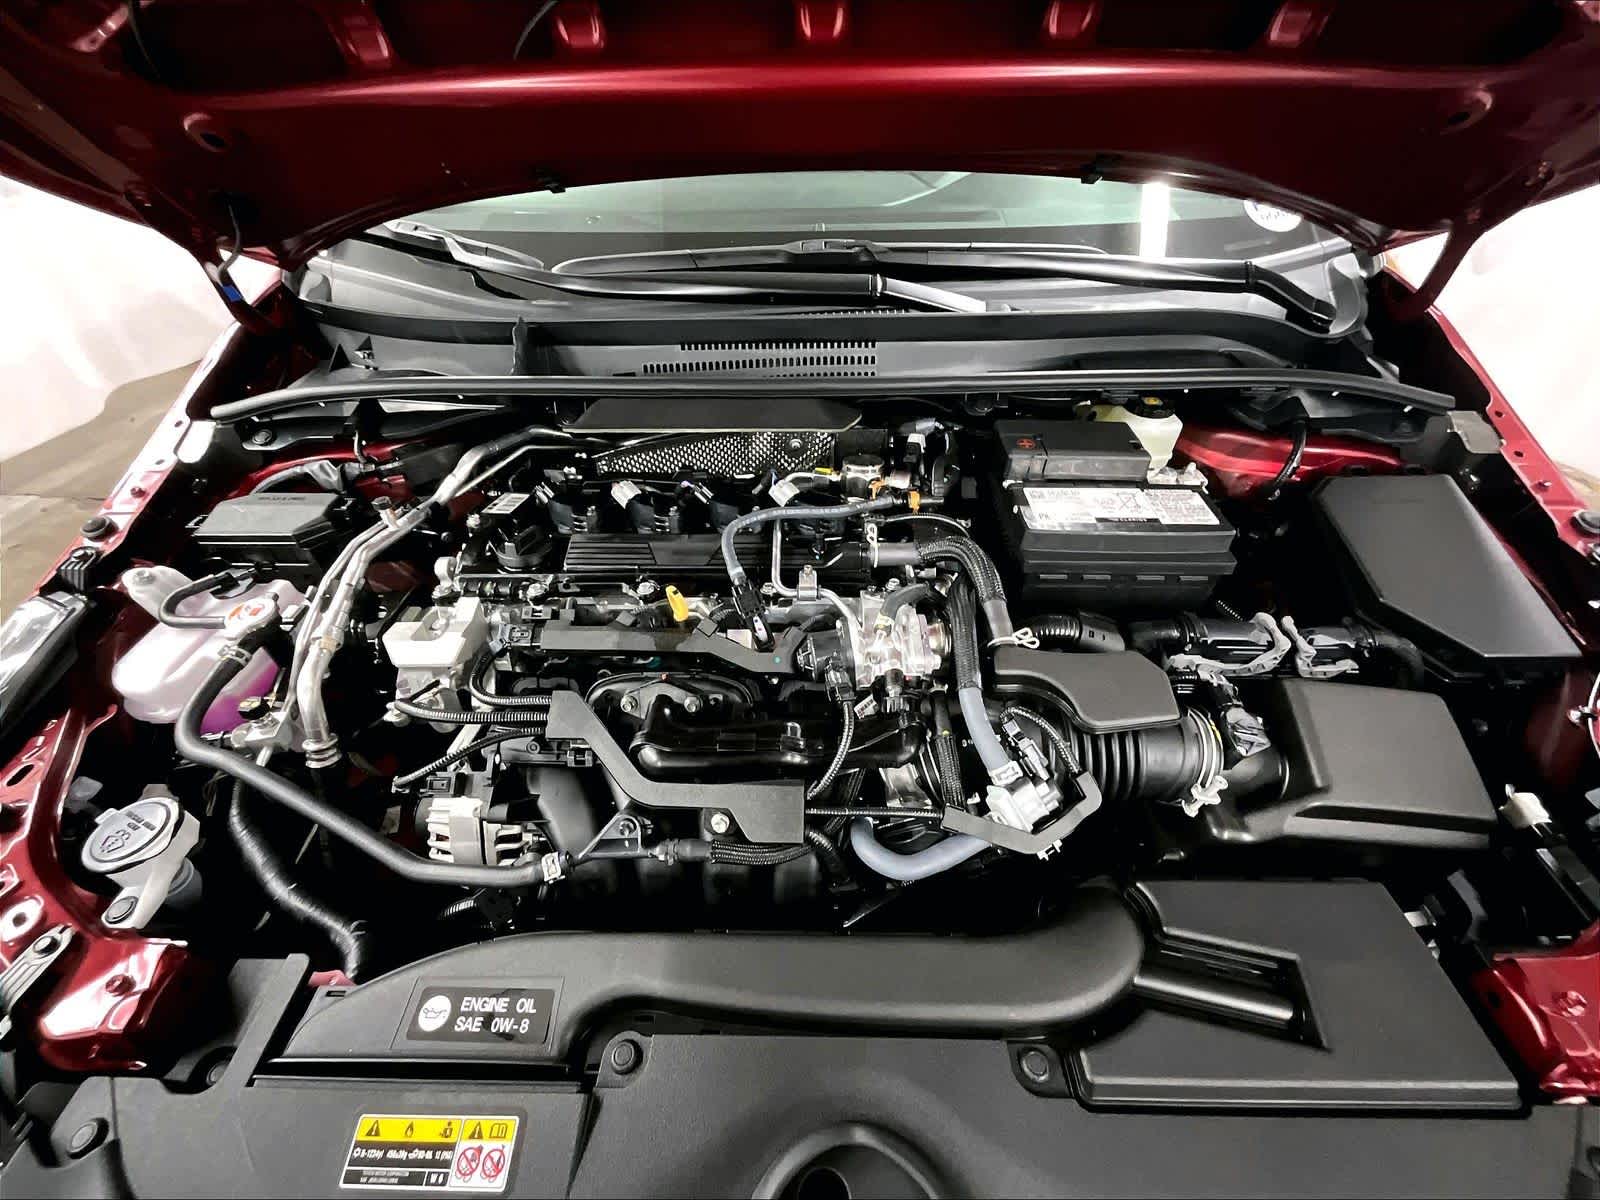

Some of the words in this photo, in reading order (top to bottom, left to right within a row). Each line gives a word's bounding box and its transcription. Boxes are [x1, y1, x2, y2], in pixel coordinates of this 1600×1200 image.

[461, 997, 510, 1013] ENGINE
[516, 998, 537, 1014] OIL
[454, 1016, 483, 1032] SAE
[491, 1017, 530, 1033] 0W-8
